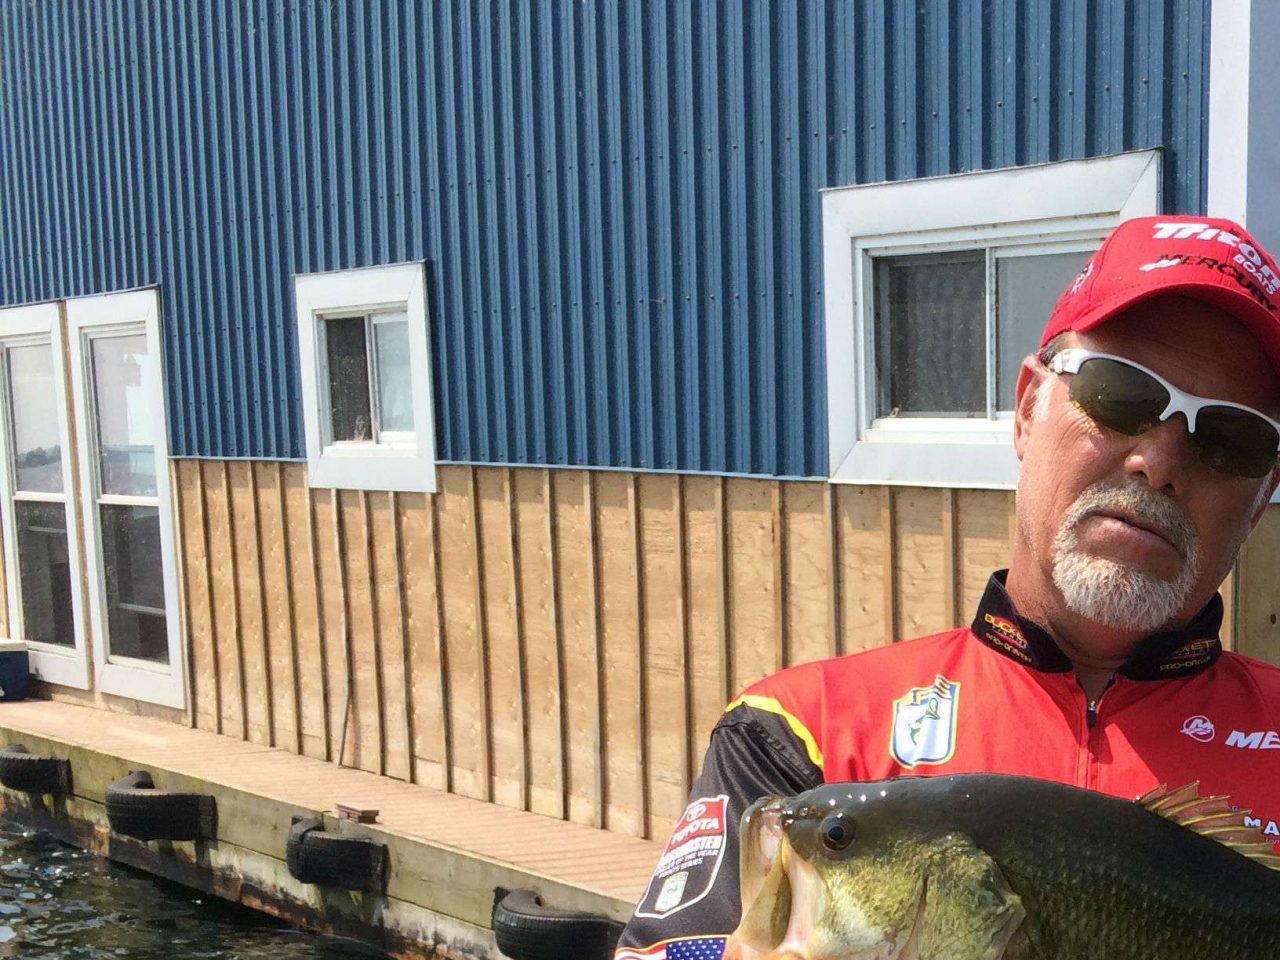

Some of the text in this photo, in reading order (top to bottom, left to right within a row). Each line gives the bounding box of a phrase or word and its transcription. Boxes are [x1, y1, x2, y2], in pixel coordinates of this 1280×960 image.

[1157, 253, 1278, 311] MERCURY
[1232, 253, 1276, 295] BOATS
[671, 818, 719, 845] TOYOTA
